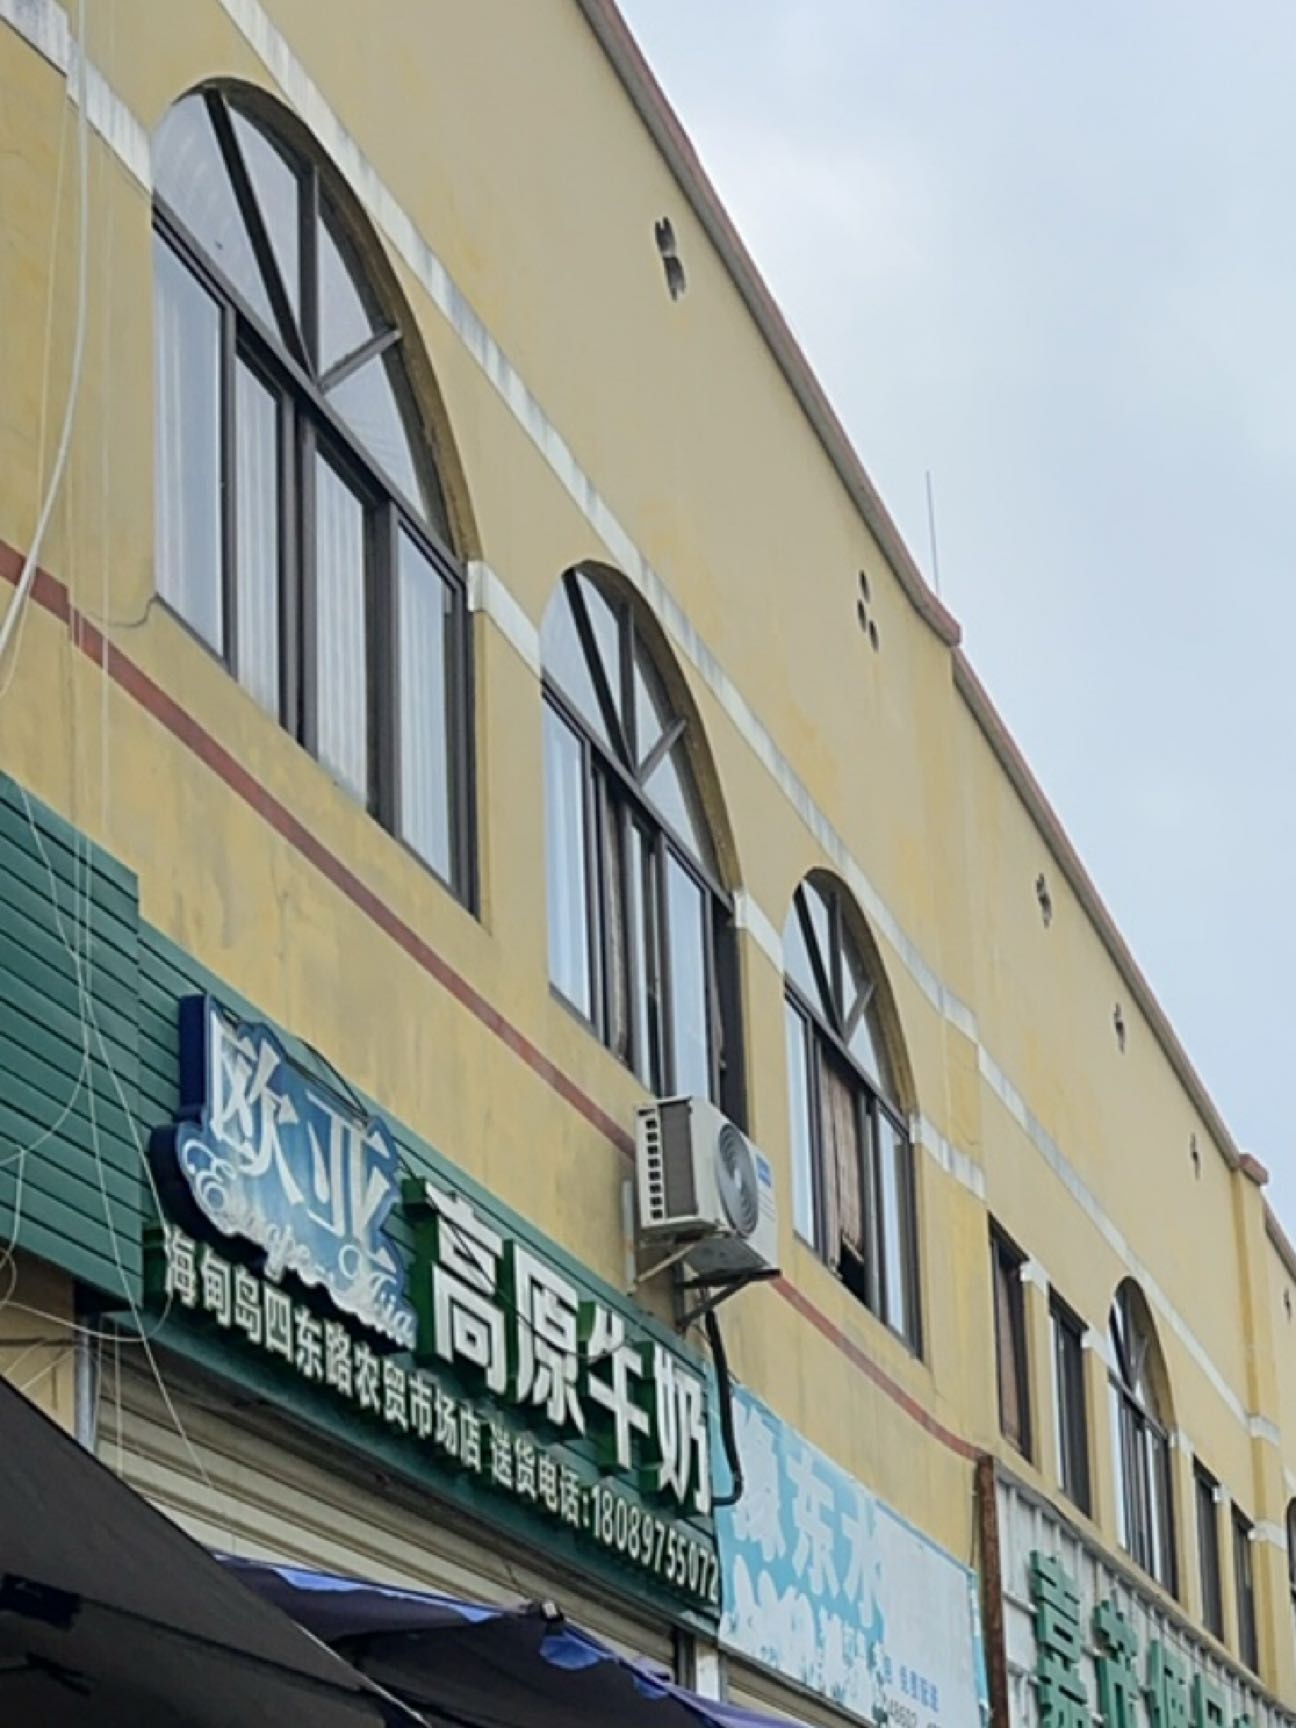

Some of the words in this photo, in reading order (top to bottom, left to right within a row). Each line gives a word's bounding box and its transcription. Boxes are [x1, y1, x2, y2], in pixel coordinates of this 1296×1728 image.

[208, 1008, 398, 1275] 欧亚
[424, 1181, 712, 1514] 高原牛奶
